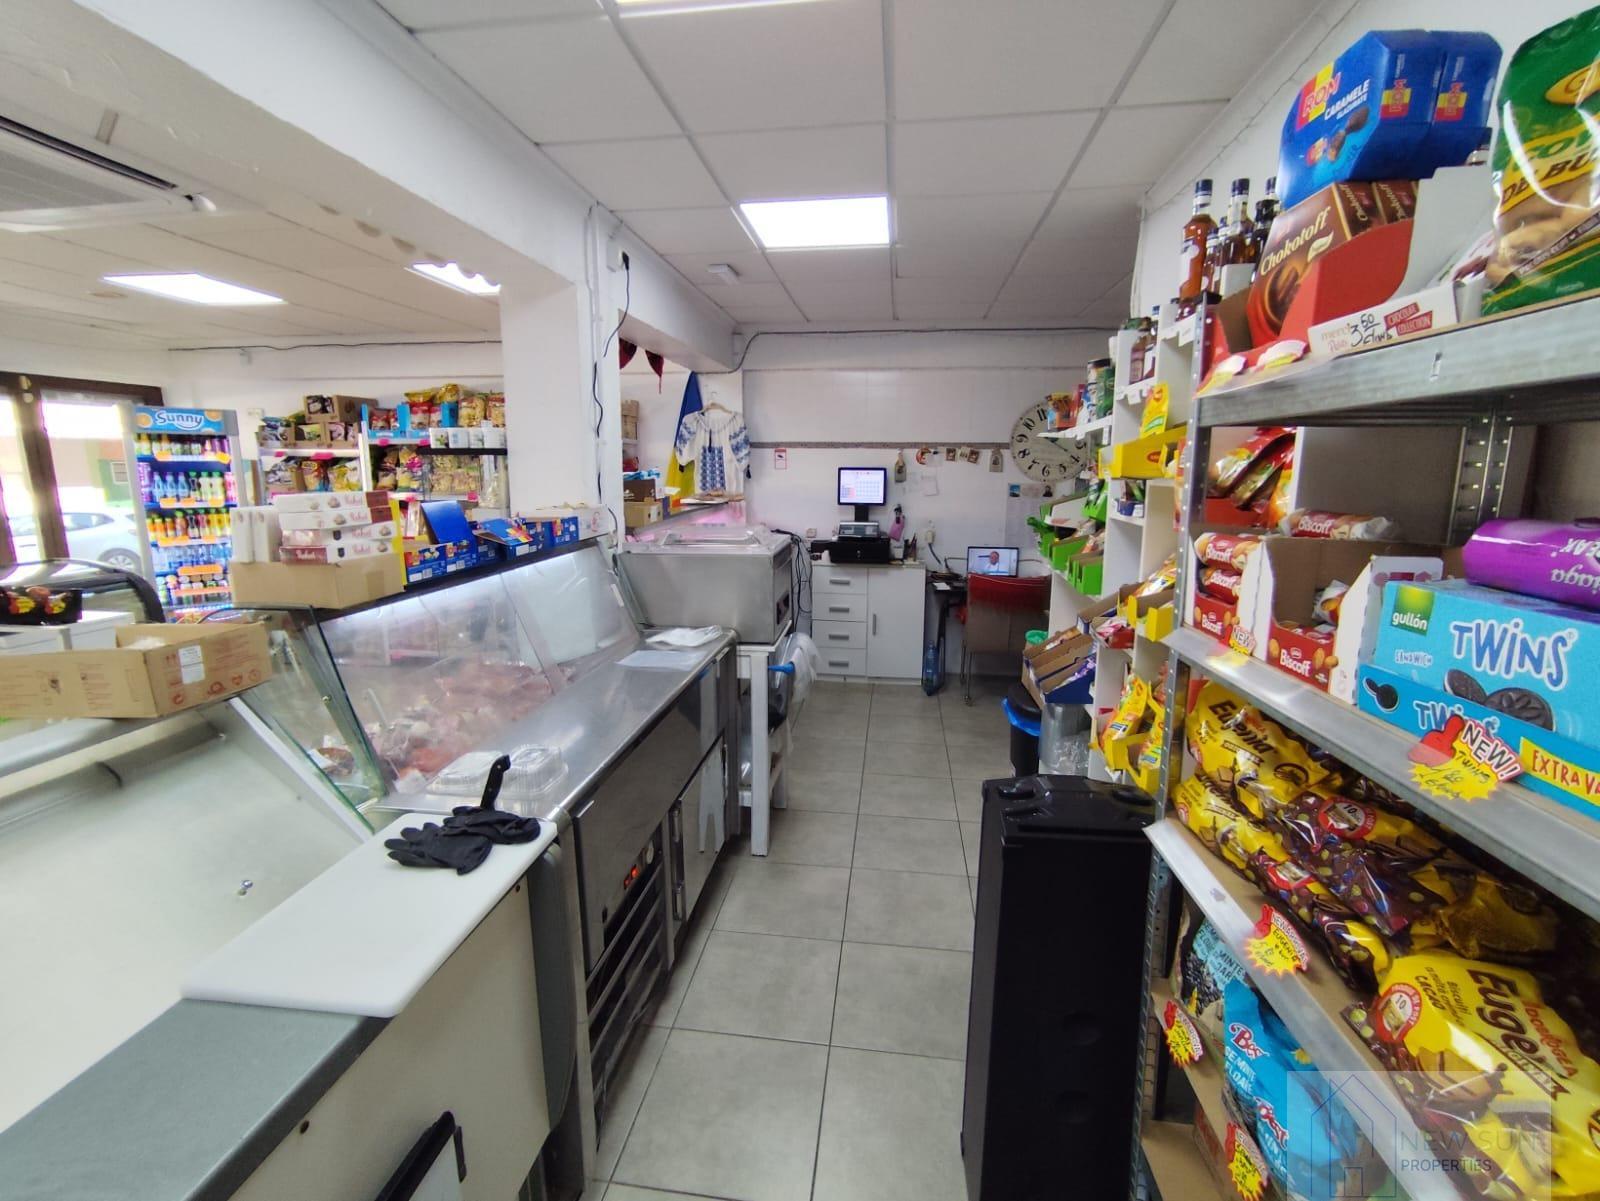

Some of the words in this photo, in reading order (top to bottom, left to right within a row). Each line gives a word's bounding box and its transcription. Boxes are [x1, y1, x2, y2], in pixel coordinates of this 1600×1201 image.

[1325, 79, 1370, 120] CARAMELE
[1261, 206, 1331, 276] Chokotoff
[154, 410, 204, 430] Sunny
[1299, 516, 1336, 534] Biscoff
[1205, 543, 1233, 563] Biscoff
[1210, 572, 1239, 588] Biscoff
[1202, 616, 1222, 635] Biscoff
[1392, 610, 1428, 631] gullón
[1280, 649, 1312, 677] Biscoff
[1463, 723, 1520, 778] NEW!
[1532, 750, 1581, 786] EXTRA
[1343, 804, 1357, 814] 10
[1395, 994, 1407, 1010] 10
[1415, 975, 1447, 1010] CACAO
